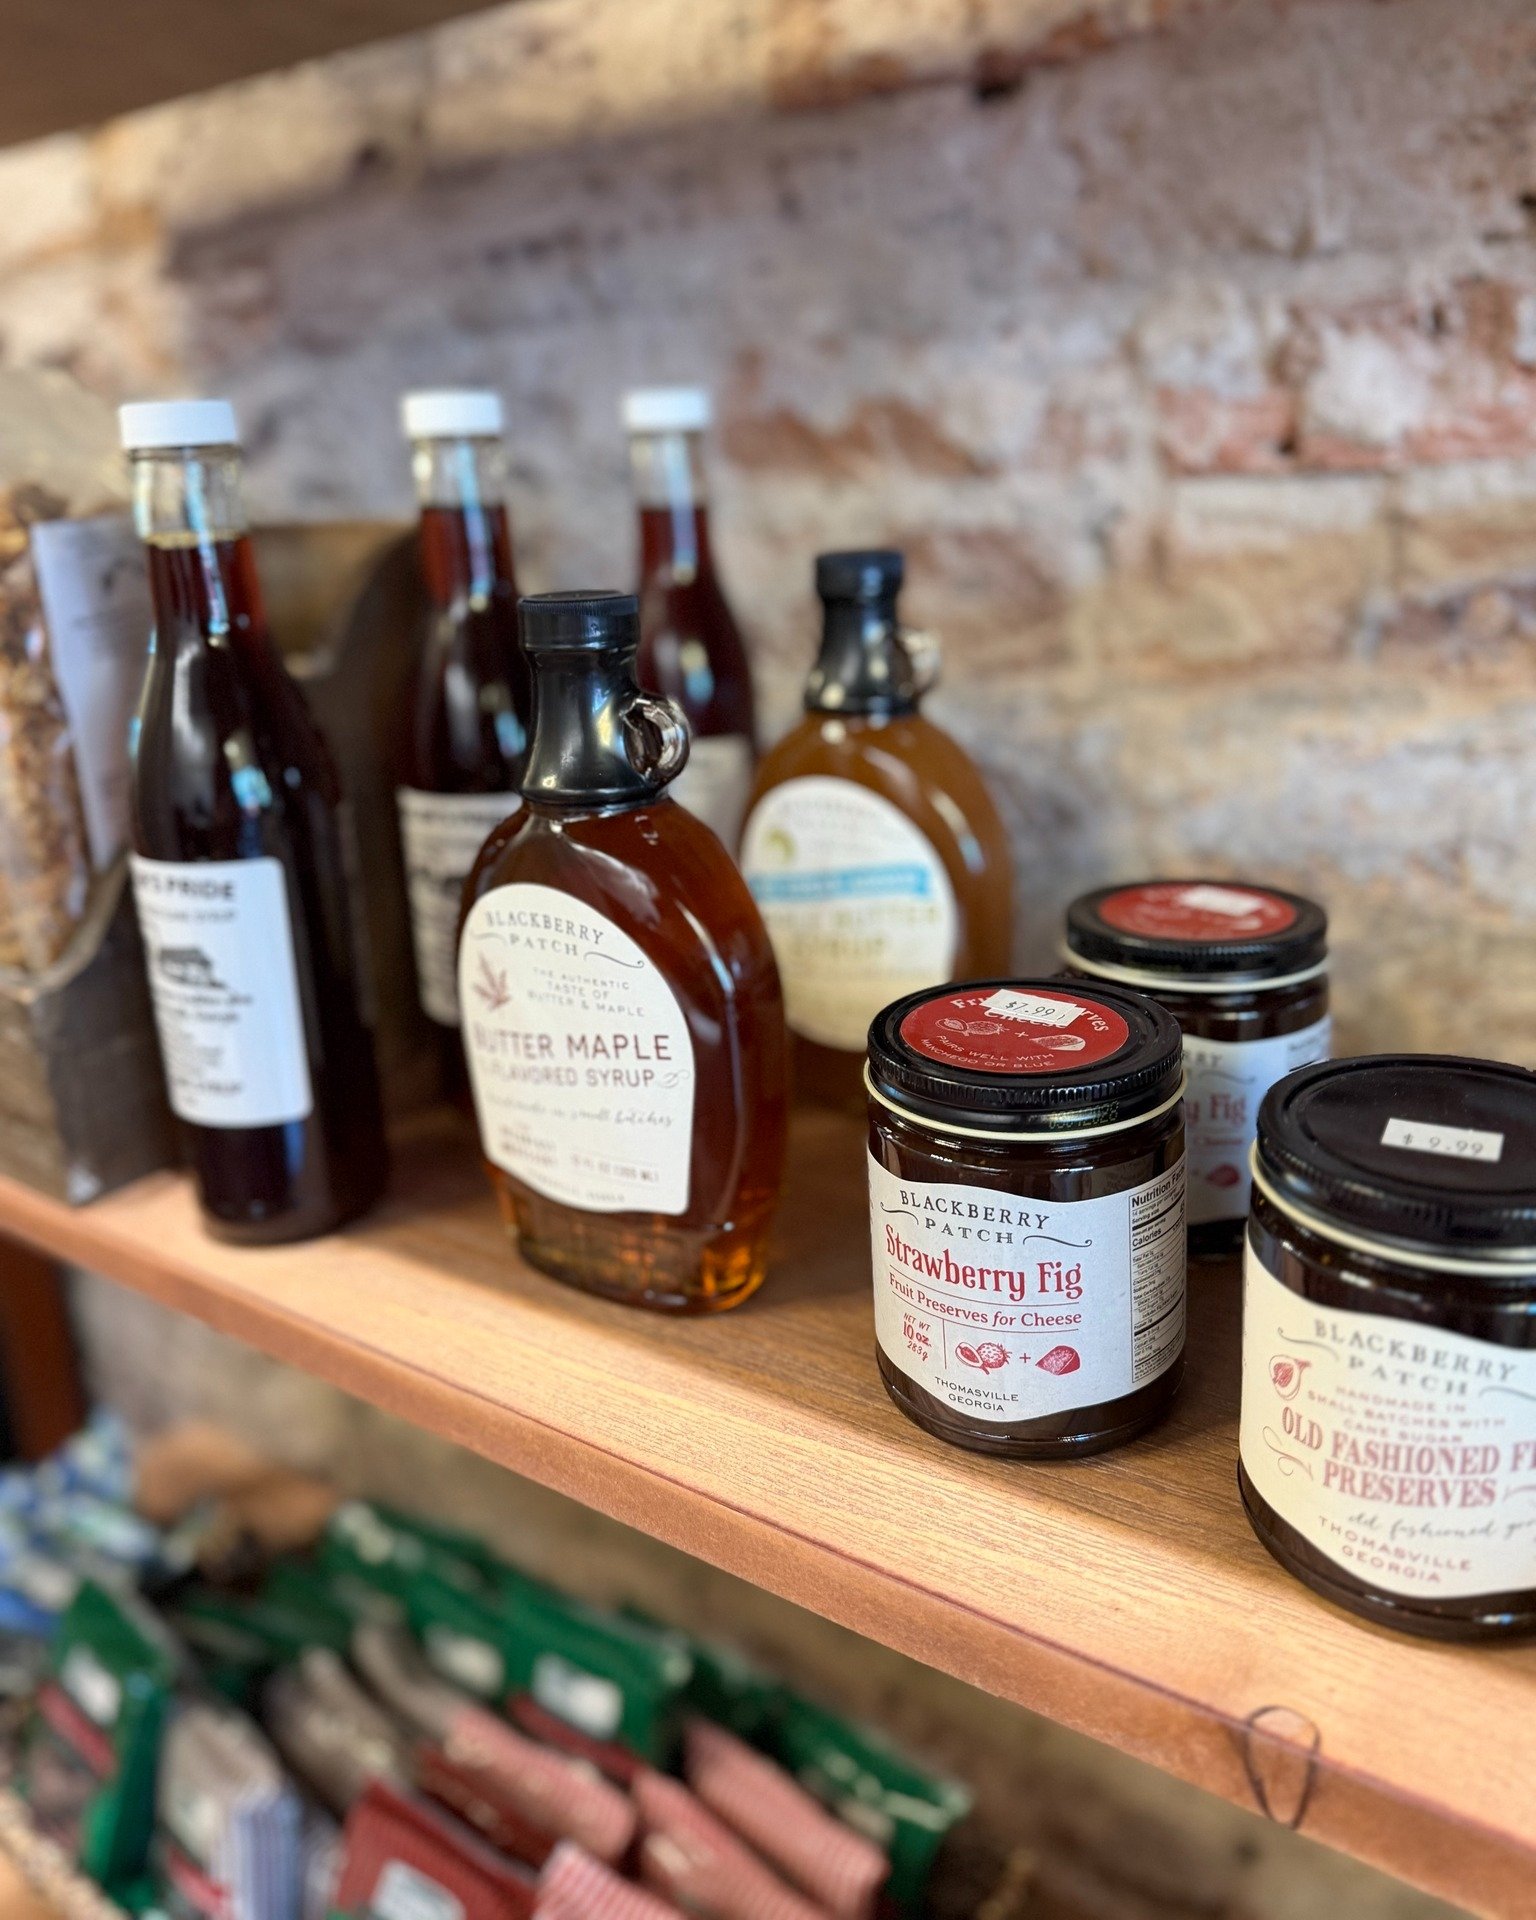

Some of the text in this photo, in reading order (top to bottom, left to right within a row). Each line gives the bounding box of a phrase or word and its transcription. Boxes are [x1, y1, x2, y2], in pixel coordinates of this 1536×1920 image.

[485, 910, 604, 945] BLACKBERRY
[510, 932, 578, 956] PATCH
[547, 980, 609, 1000] TASTE OF
[561, 973, 629, 990] AUTHENTIC
[596, 1002, 645, 1018] MAPLE
[1005, 1000, 1056, 1017] $7.99
[566, 1034, 672, 1061] MAPLE
[969, 1050, 1009, 1061] WELL
[1016, 1053, 1054, 1061] WITH
[586, 1068, 655, 1088] SYRUP
[1014, 1061, 1055, 1069] BLUE
[1131, 1181, 1170, 1208] Nutrition
[899, 1190, 1050, 1230] BLACKBERRY
[925, 1217, 1014, 1244] PATCH
[1132, 1229, 1162, 1248] Calories
[885, 1224, 1083, 1301] Strawberry Fig
[889, 1272, 1082, 1328] Fruit Preserves for Cheese
[903, 1312, 931, 1331] NET WT
[903, 1321, 914, 1340] 10
[1314, 1319, 1517, 1382] BLACKBERRY
[935, 1376, 1019, 1402] THOMASVILLE
[1349, 1355, 1469, 1396] PATCH
[948, 1392, 1005, 1412] GEORGIA
[1308, 1390, 1356, 1414] SMALL
[1459, 1417, 1506, 1428] WITH
[1335, 1386, 1467, 1413] HANDMADE IN
[1282, 1406, 1536, 1475] OLD FASHIONED FI
[1344, 1418, 1463, 1443] CANE SUGAR
[1323, 1459, 1497, 1508] PRESERVES
[1319, 1515, 1472, 1571] THOMASVILLE
[1342, 1545, 1442, 1583] GEORGIA
